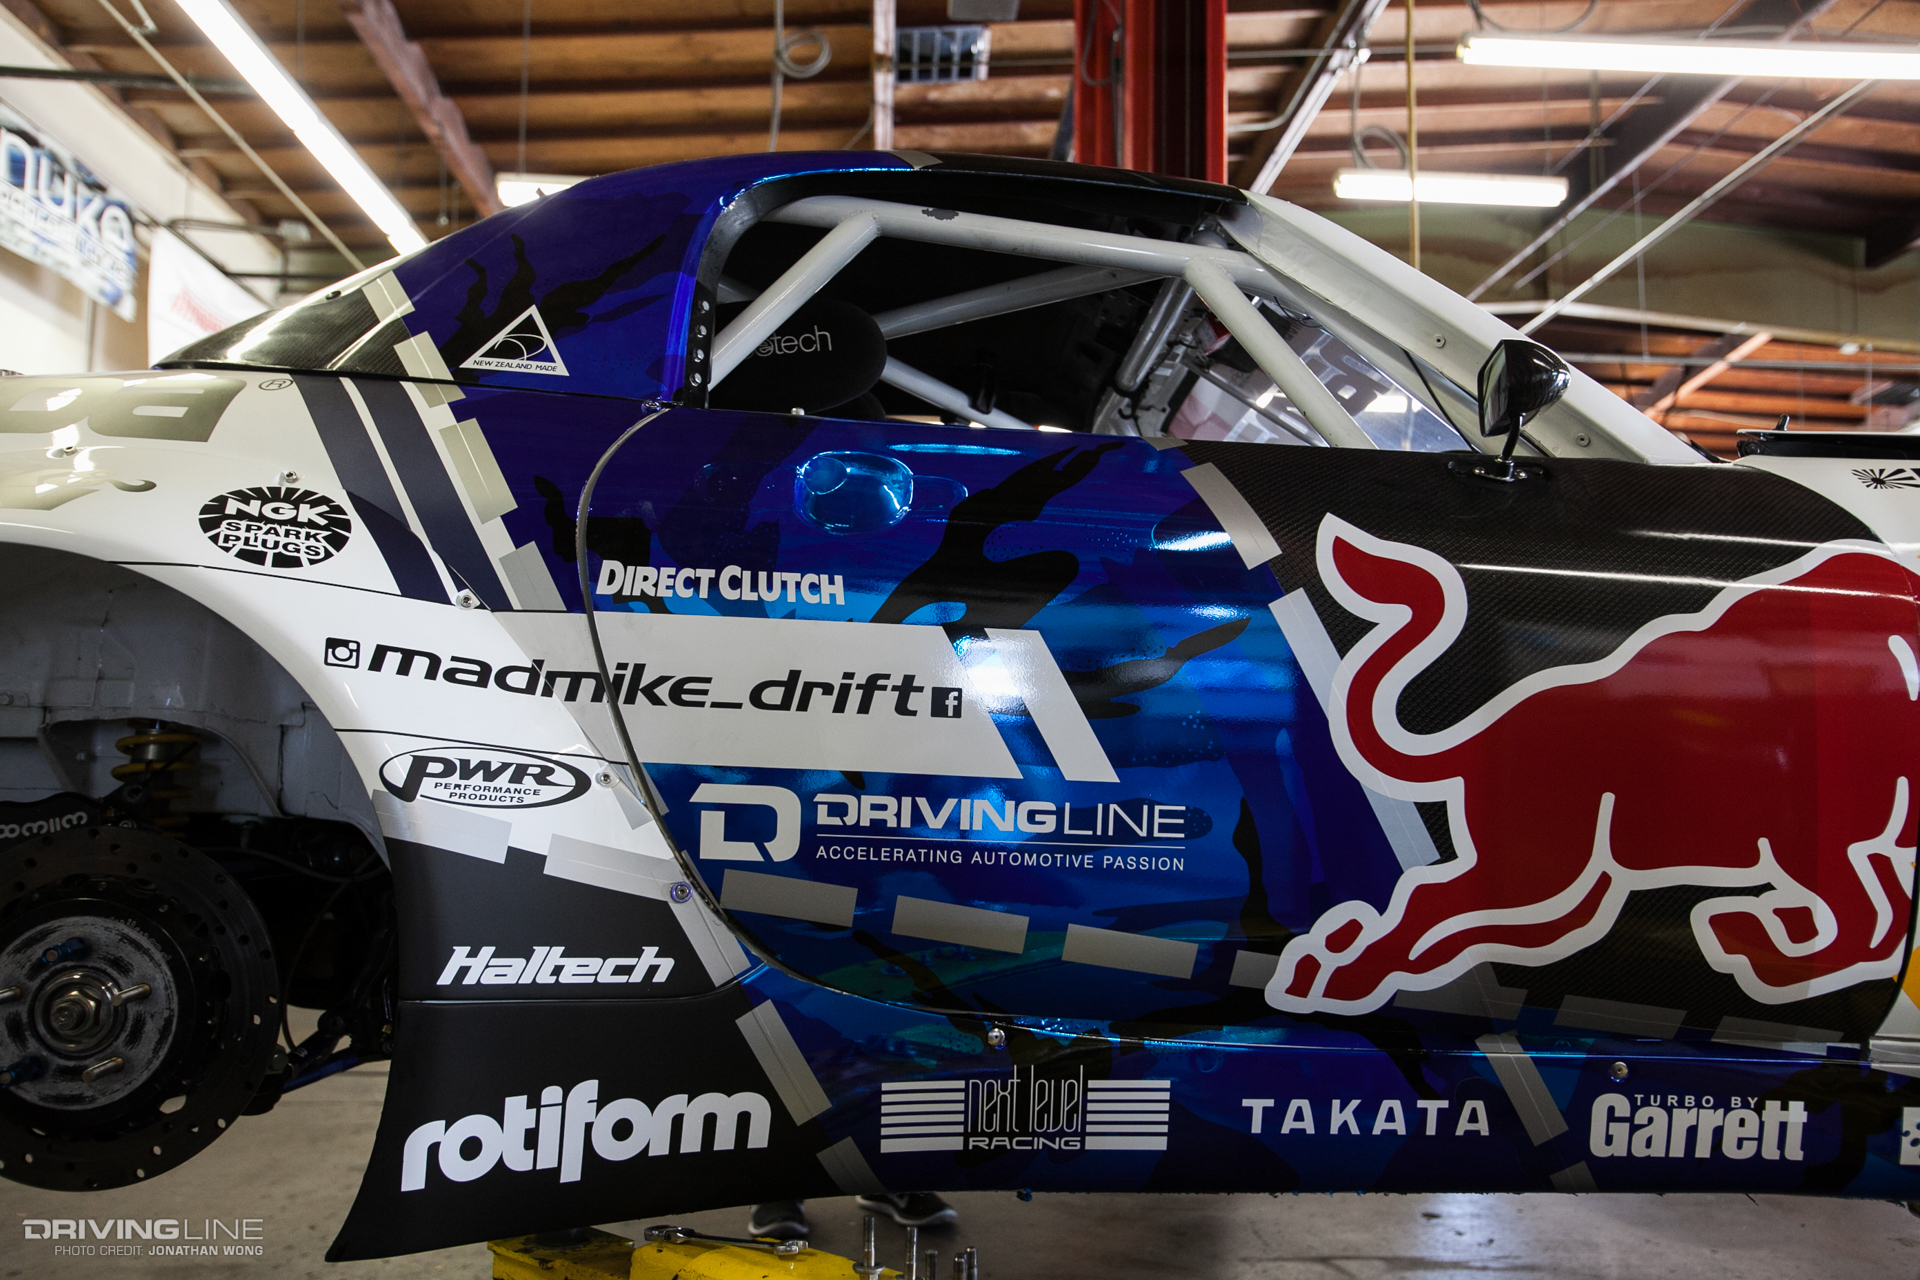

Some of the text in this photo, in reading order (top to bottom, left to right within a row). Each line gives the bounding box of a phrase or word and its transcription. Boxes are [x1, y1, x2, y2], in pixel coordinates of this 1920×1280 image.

[472, 359, 558, 372] NEW ZEALAND MADE
[224, 497, 331, 526] NGK
[224, 520, 323, 543] SPARK
[222, 534, 321, 557] PLUGS
[596, 559, 846, 605] DIRECT CLUTCH
[400, 753, 562, 803] PWR
[434, 781, 541, 797] PERFORMANCE
[448, 791, 525, 804] PRODUCTS
[816, 845, 1184, 871] ACCELERATING AUTOMOTIVE PASSION
[437, 946, 675, 985] Haltech
[968, 1064, 1084, 1133] next level
[1634, 1094, 1759, 1108] TURBO BY
[1241, 1098, 1490, 1136] TAKATA
[1589, 1093, 1808, 1161] Garrett
[401, 1080, 772, 1192] rotiform
[968, 1137, 1081, 1150] RACING
